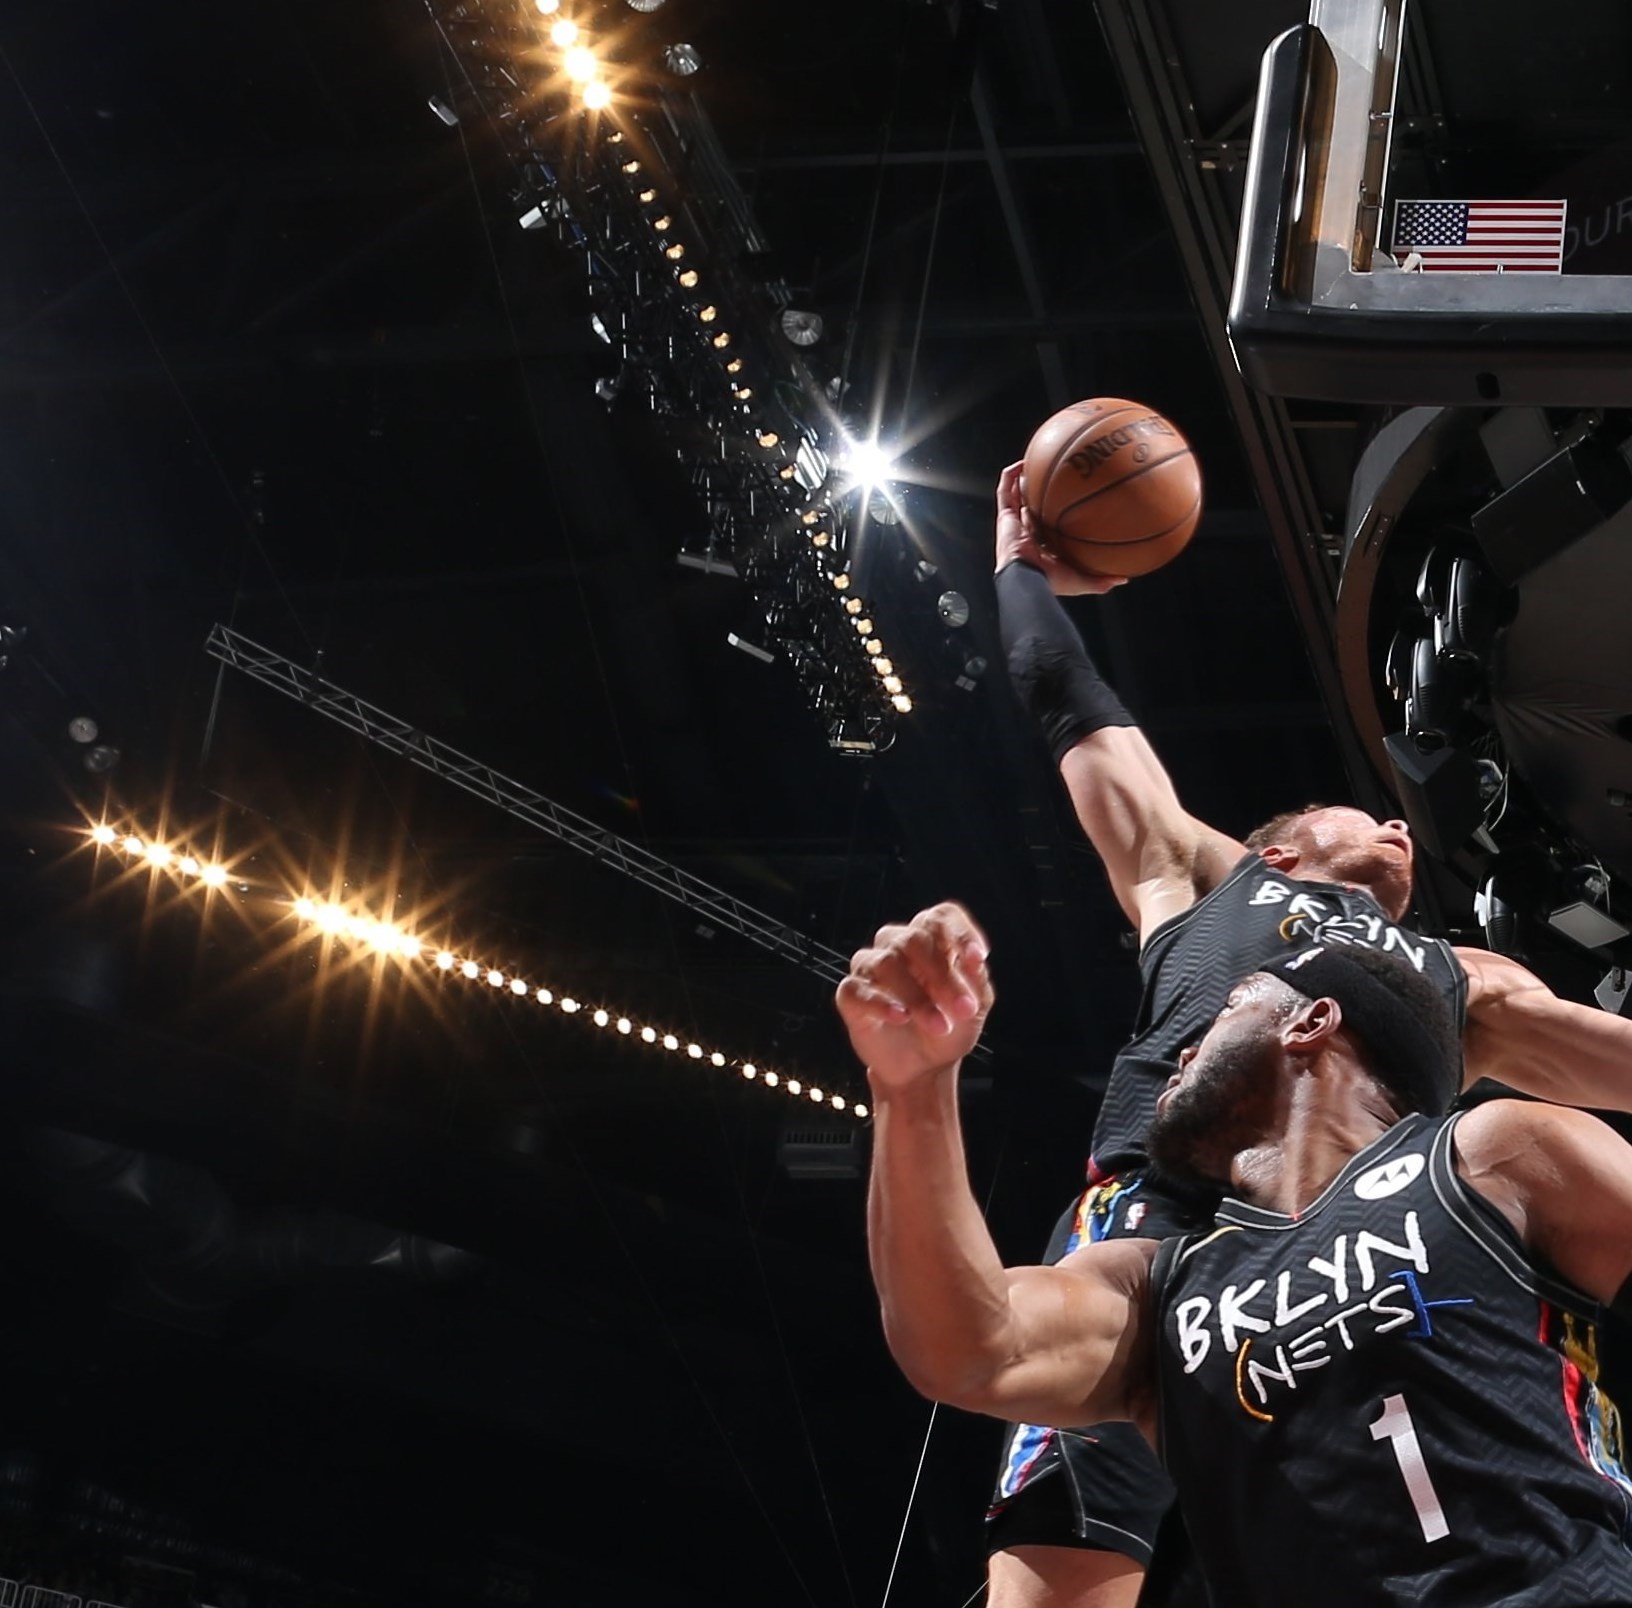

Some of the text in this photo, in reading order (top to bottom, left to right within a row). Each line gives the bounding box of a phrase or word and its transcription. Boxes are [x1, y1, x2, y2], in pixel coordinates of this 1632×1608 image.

[1175, 1211, 1430, 1374] BKLYN
[1247, 1284, 1415, 1404] NETS
[1369, 1393, 1451, 1543] 1
